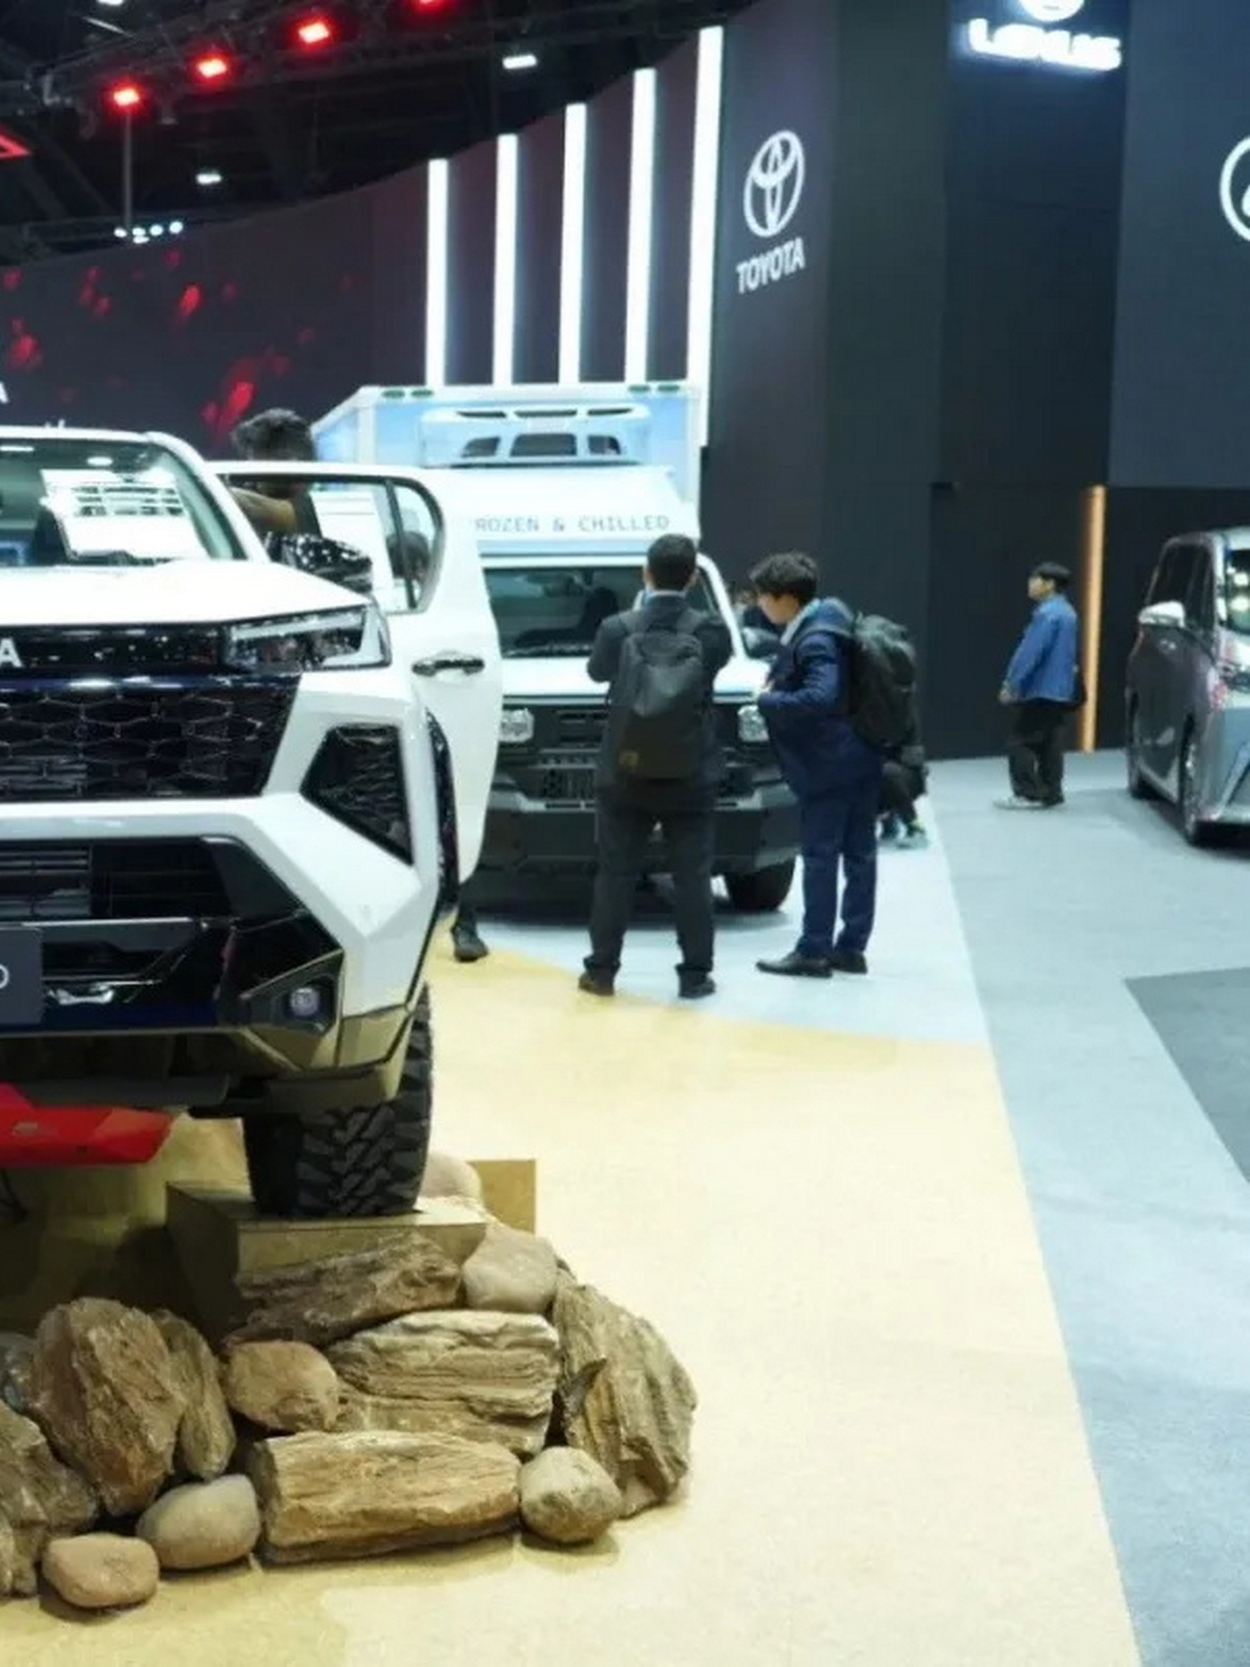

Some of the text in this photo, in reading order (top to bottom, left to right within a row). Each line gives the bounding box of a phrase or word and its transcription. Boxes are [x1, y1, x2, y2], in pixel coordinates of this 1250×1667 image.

[736, 236, 805, 294] TOYOTA
[474, 515, 540, 532] ROZEN
[577, 514, 670, 532] CHILLED
